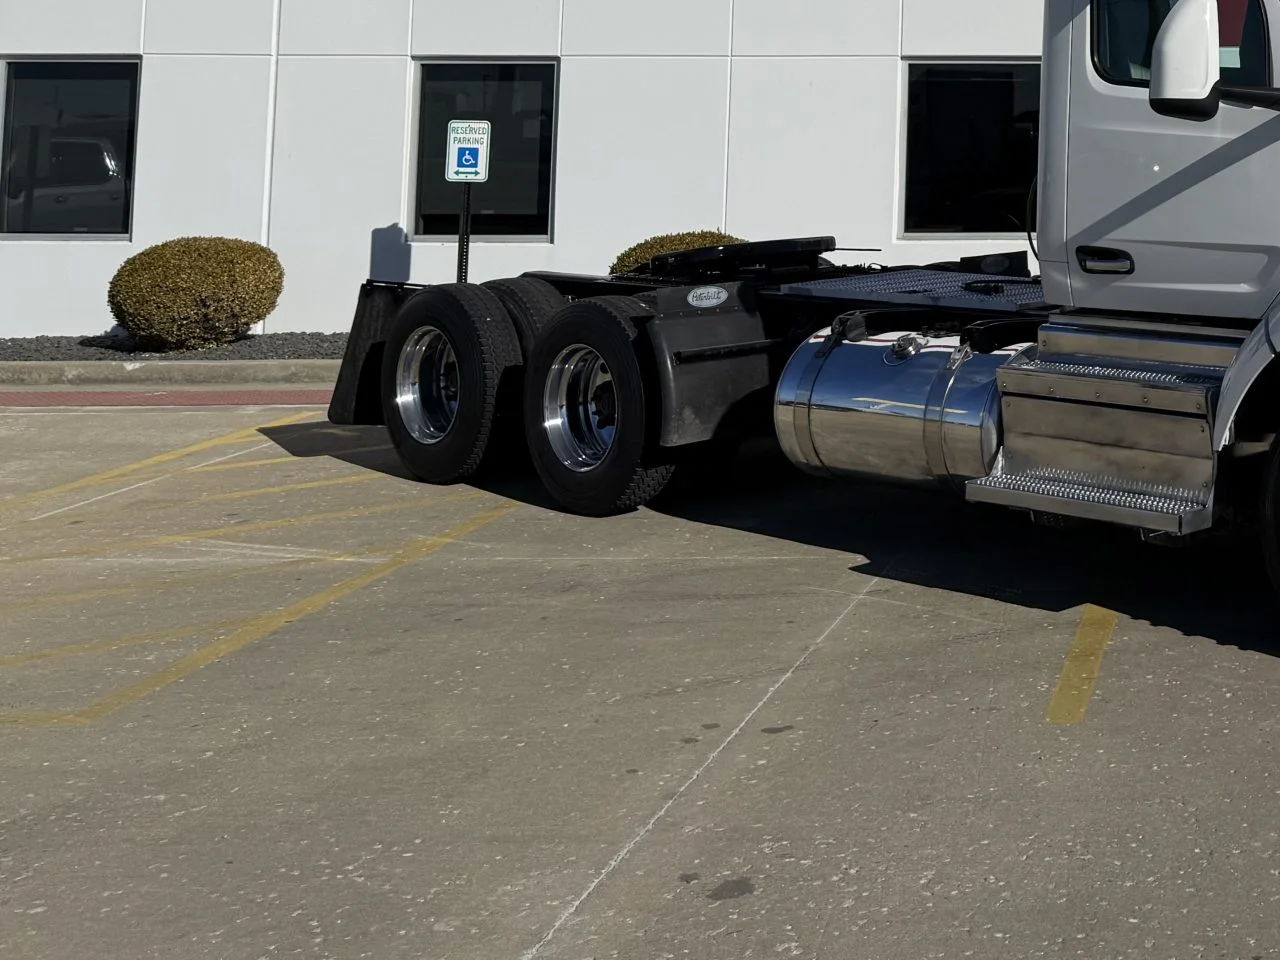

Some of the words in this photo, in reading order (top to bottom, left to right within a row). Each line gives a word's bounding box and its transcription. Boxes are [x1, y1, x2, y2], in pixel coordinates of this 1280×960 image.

[451, 126, 487, 135] RESERVED
[453, 136, 485, 145] PARKING
[691, 290, 724, 303] Peterbilt
